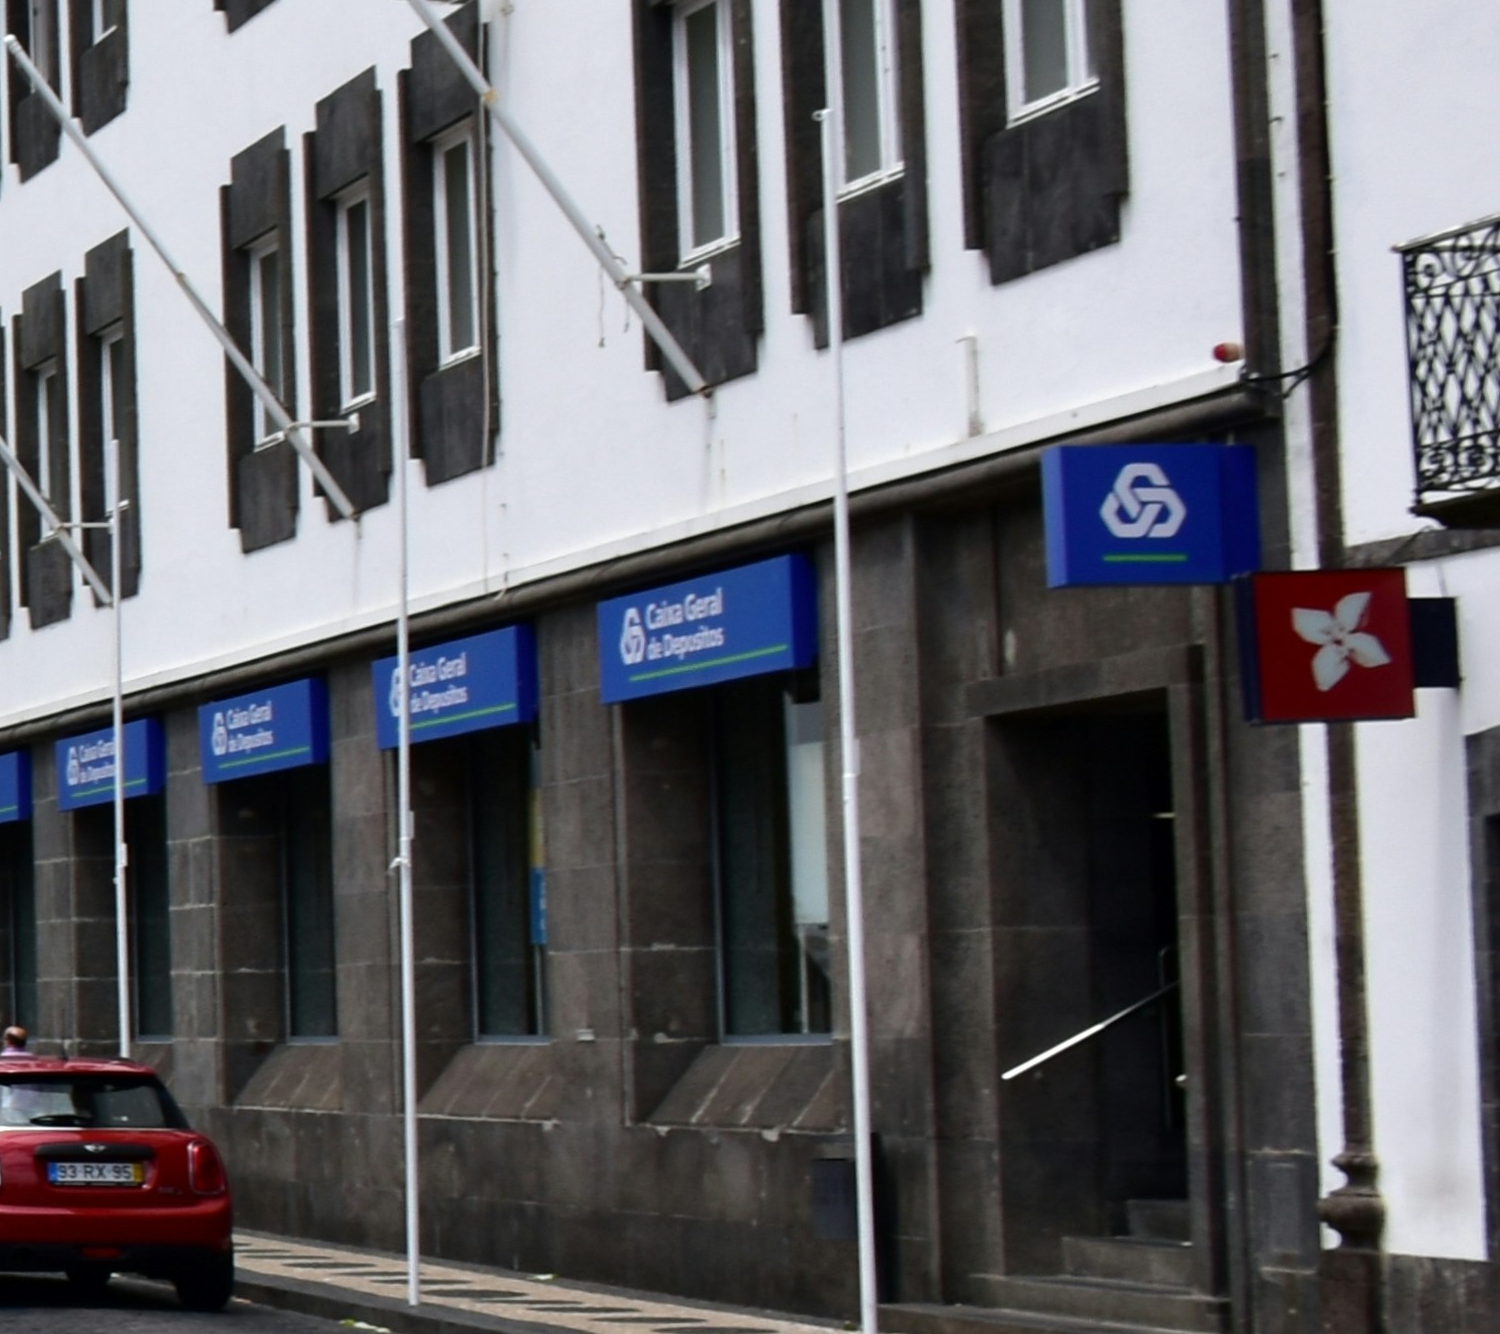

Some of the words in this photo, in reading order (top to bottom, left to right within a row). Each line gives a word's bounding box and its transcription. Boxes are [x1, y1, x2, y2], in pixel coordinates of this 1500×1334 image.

[645, 600, 684, 631] Caixa
[684, 586, 723, 621] Geral
[647, 637, 663, 660] de
[409, 662, 437, 688] Caixa
[437, 651, 467, 681] Geral
[227, 709, 249, 730] Caixa
[249, 700, 273, 725] Geral
